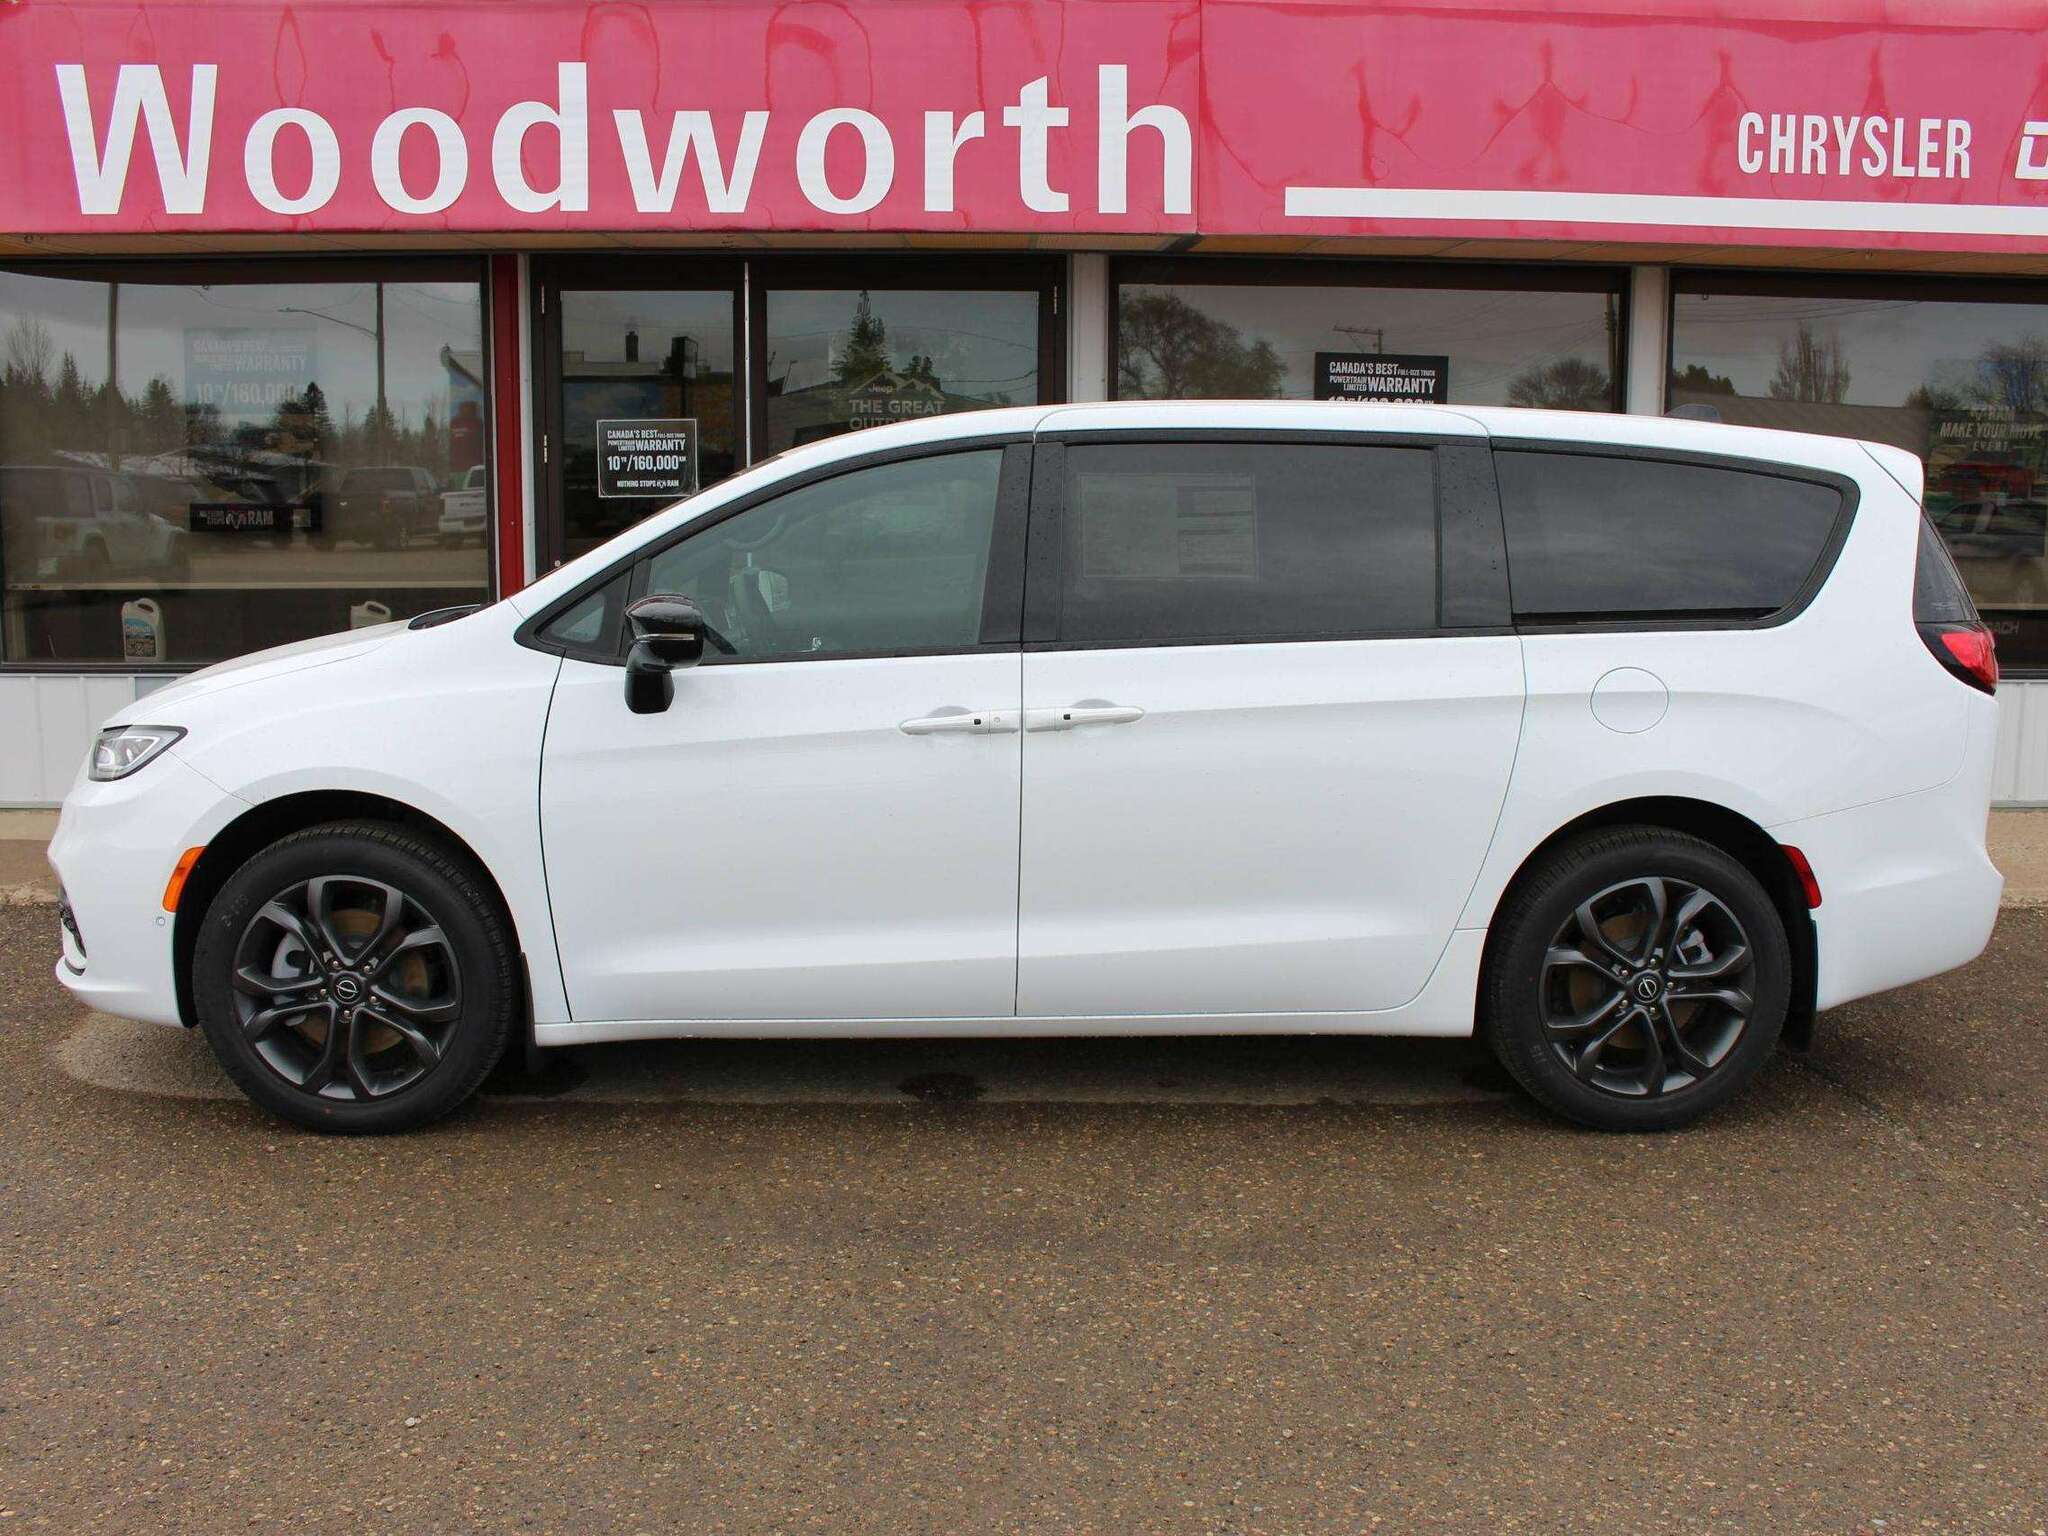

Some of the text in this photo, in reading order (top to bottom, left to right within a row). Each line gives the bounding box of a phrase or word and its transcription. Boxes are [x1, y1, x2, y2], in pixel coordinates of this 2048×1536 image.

[55, 62, 1192, 216] Woodworth
[1738, 112, 1972, 179] CHRYSLER
[1329, 361, 1374, 375] CANADA'S
[1375, 363, 1398, 376] BEST
[1329, 375, 1436, 394] POWERTRAIN WARRANTY
[1343, 383, 1367, 392] LIMITED
[849, 400, 945, 414] THE GREAT
[607, 430, 640, 439] CANADA'S
[641, 429, 657, 439] BEST
[1940, 422, 1974, 438] MAKE
[1976, 423, 2008, 439] YOUR
[636, 439, 686, 451] WARRANTY
[247, 510, 274, 525] RAM
